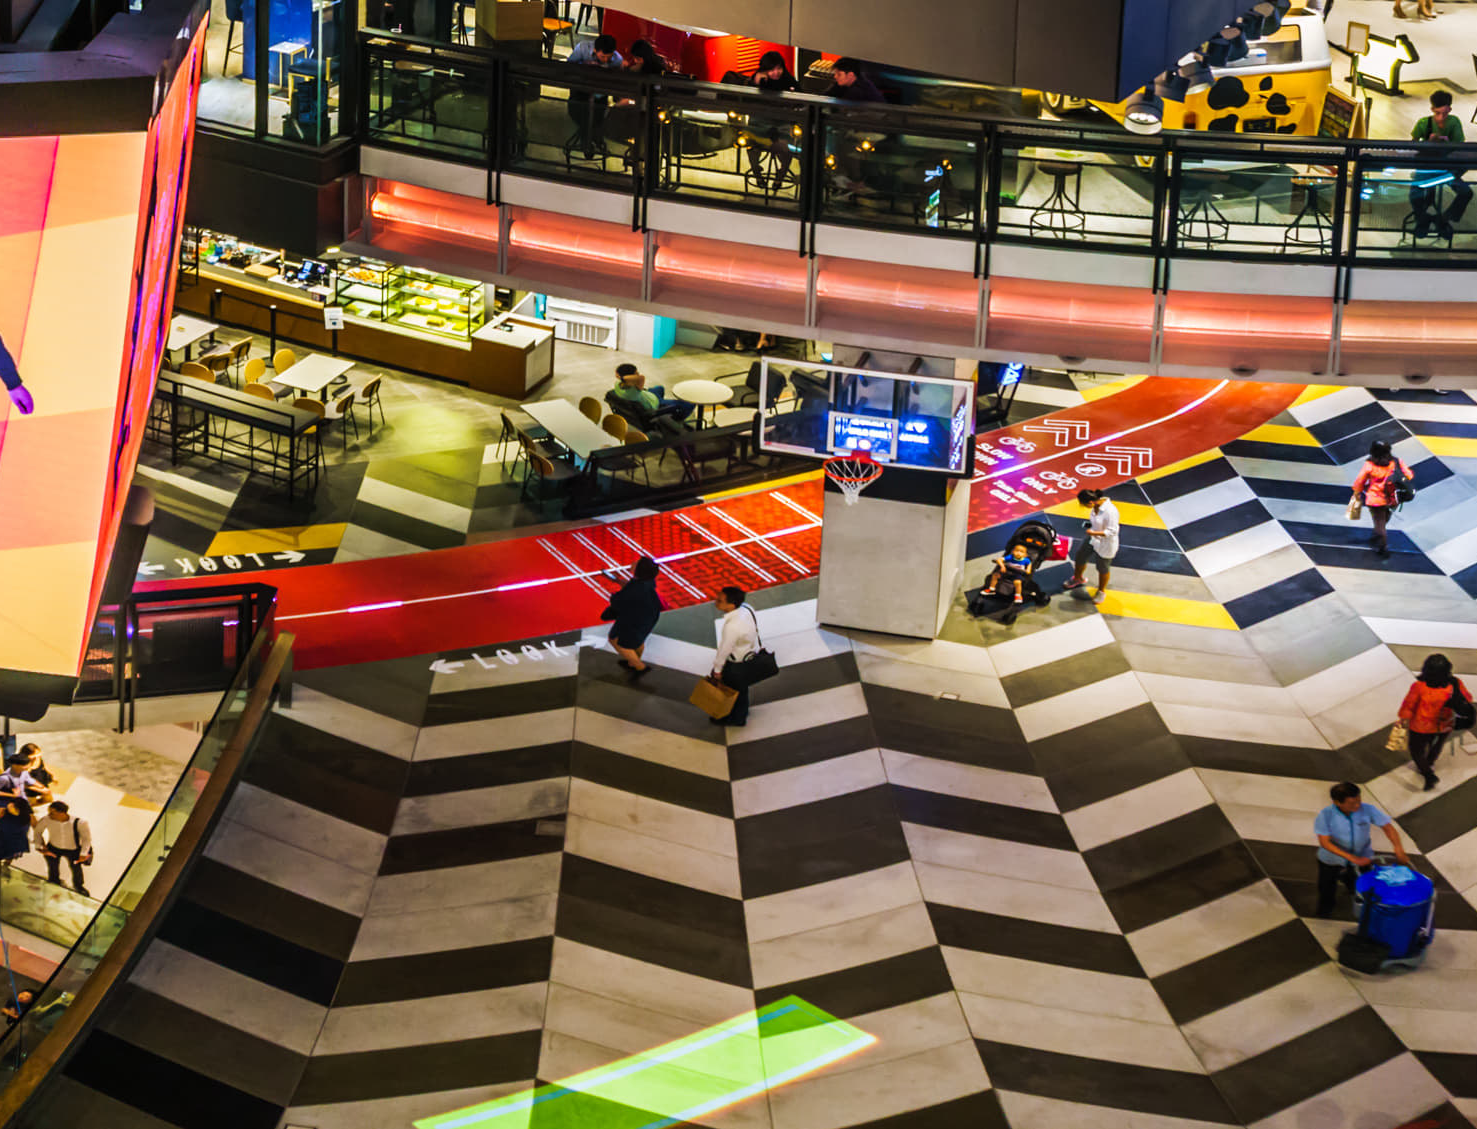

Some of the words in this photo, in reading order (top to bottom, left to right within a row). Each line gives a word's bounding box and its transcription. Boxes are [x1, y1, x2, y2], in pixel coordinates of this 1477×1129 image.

[976, 443, 1014, 460] SLOW
[1021, 476, 1058, 494] ONLY
[174, 553, 266, 574] LOOK
[472, 640, 570, 669] LOOK
